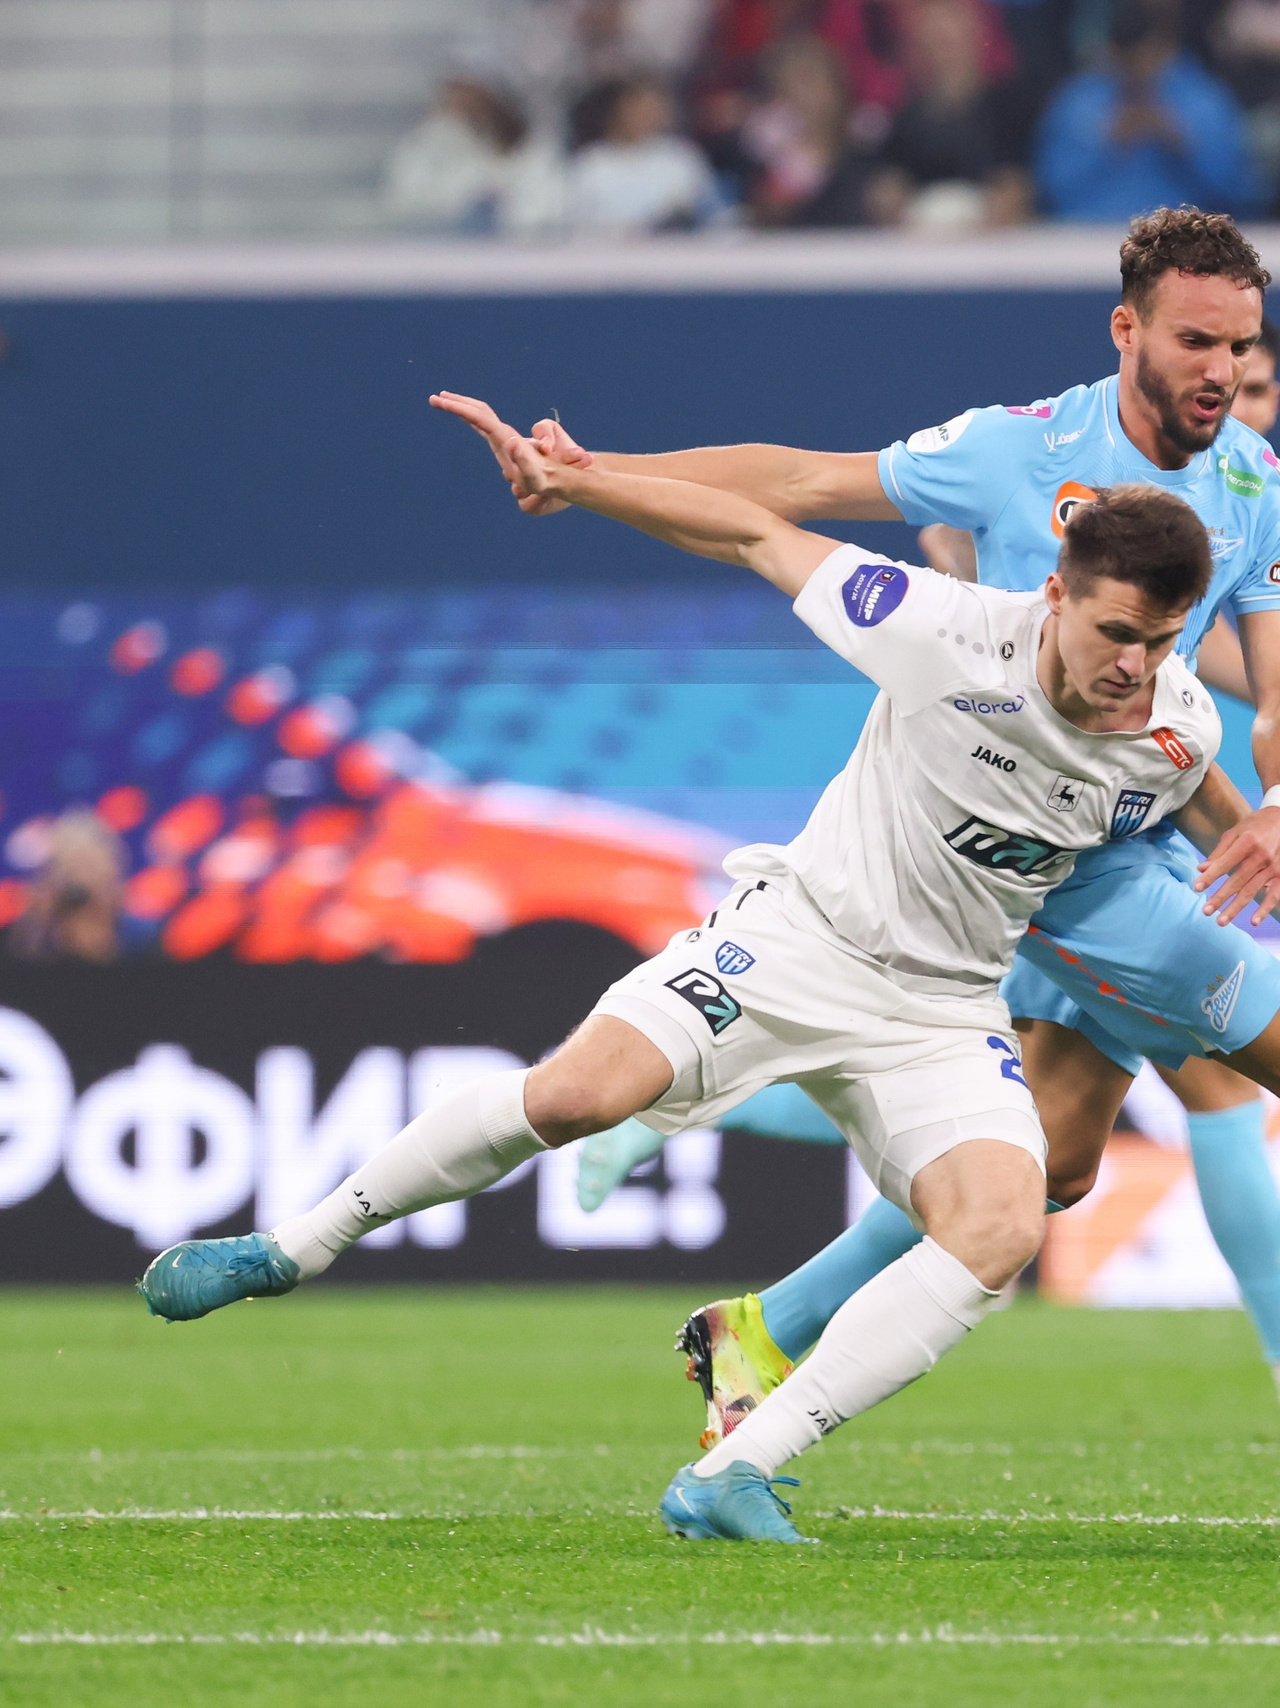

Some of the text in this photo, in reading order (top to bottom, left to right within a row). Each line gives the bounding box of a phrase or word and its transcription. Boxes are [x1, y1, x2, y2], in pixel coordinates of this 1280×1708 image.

[864, 584, 885, 621] МИР
[970, 744, 1017, 773] JAKO
[1120, 793, 1152, 805] PARI
